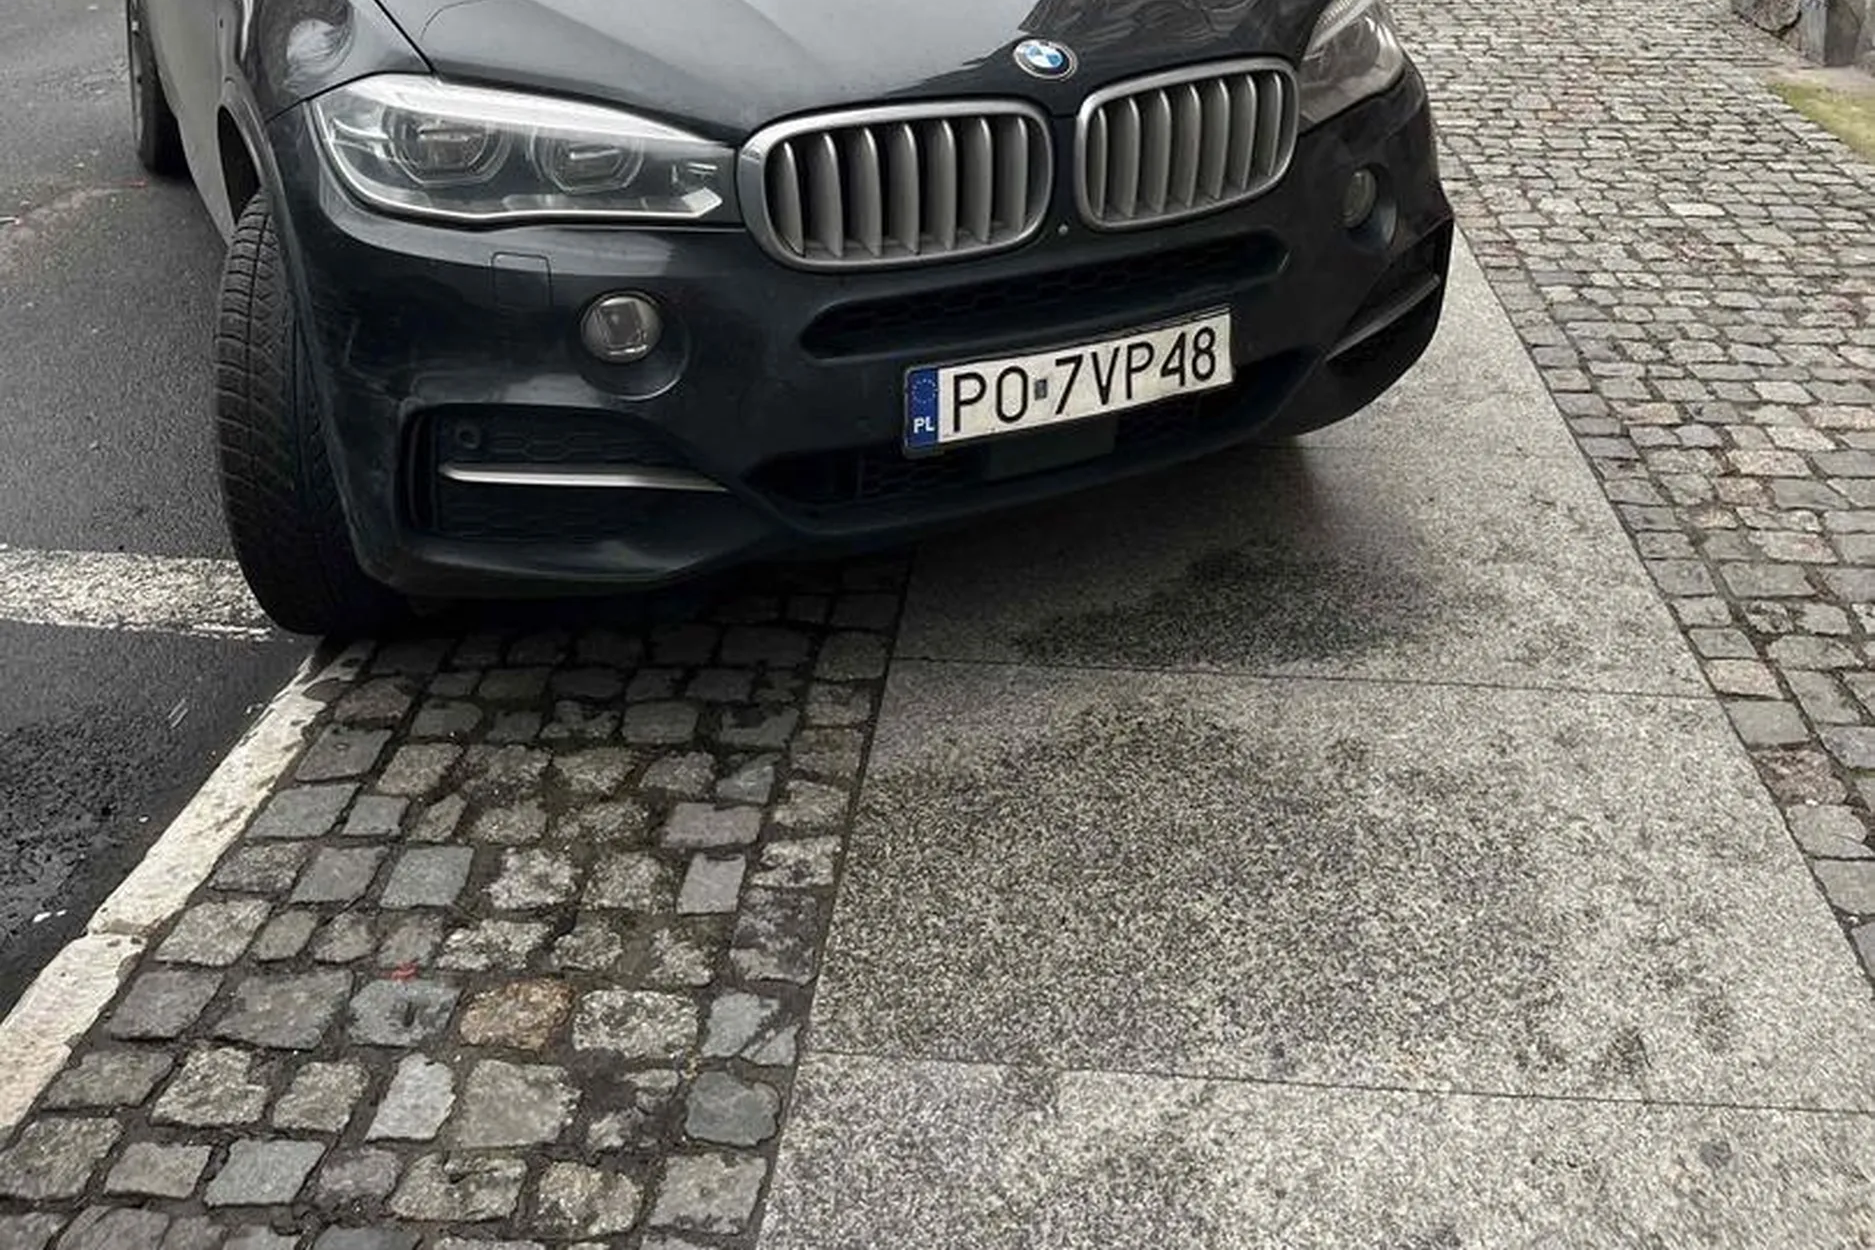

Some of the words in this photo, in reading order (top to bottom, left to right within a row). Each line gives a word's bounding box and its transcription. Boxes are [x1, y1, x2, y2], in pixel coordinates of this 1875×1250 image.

[952, 365, 1029, 432] PO
[1054, 326, 1217, 416] 7VP48
[913, 416, 935, 434] PL
